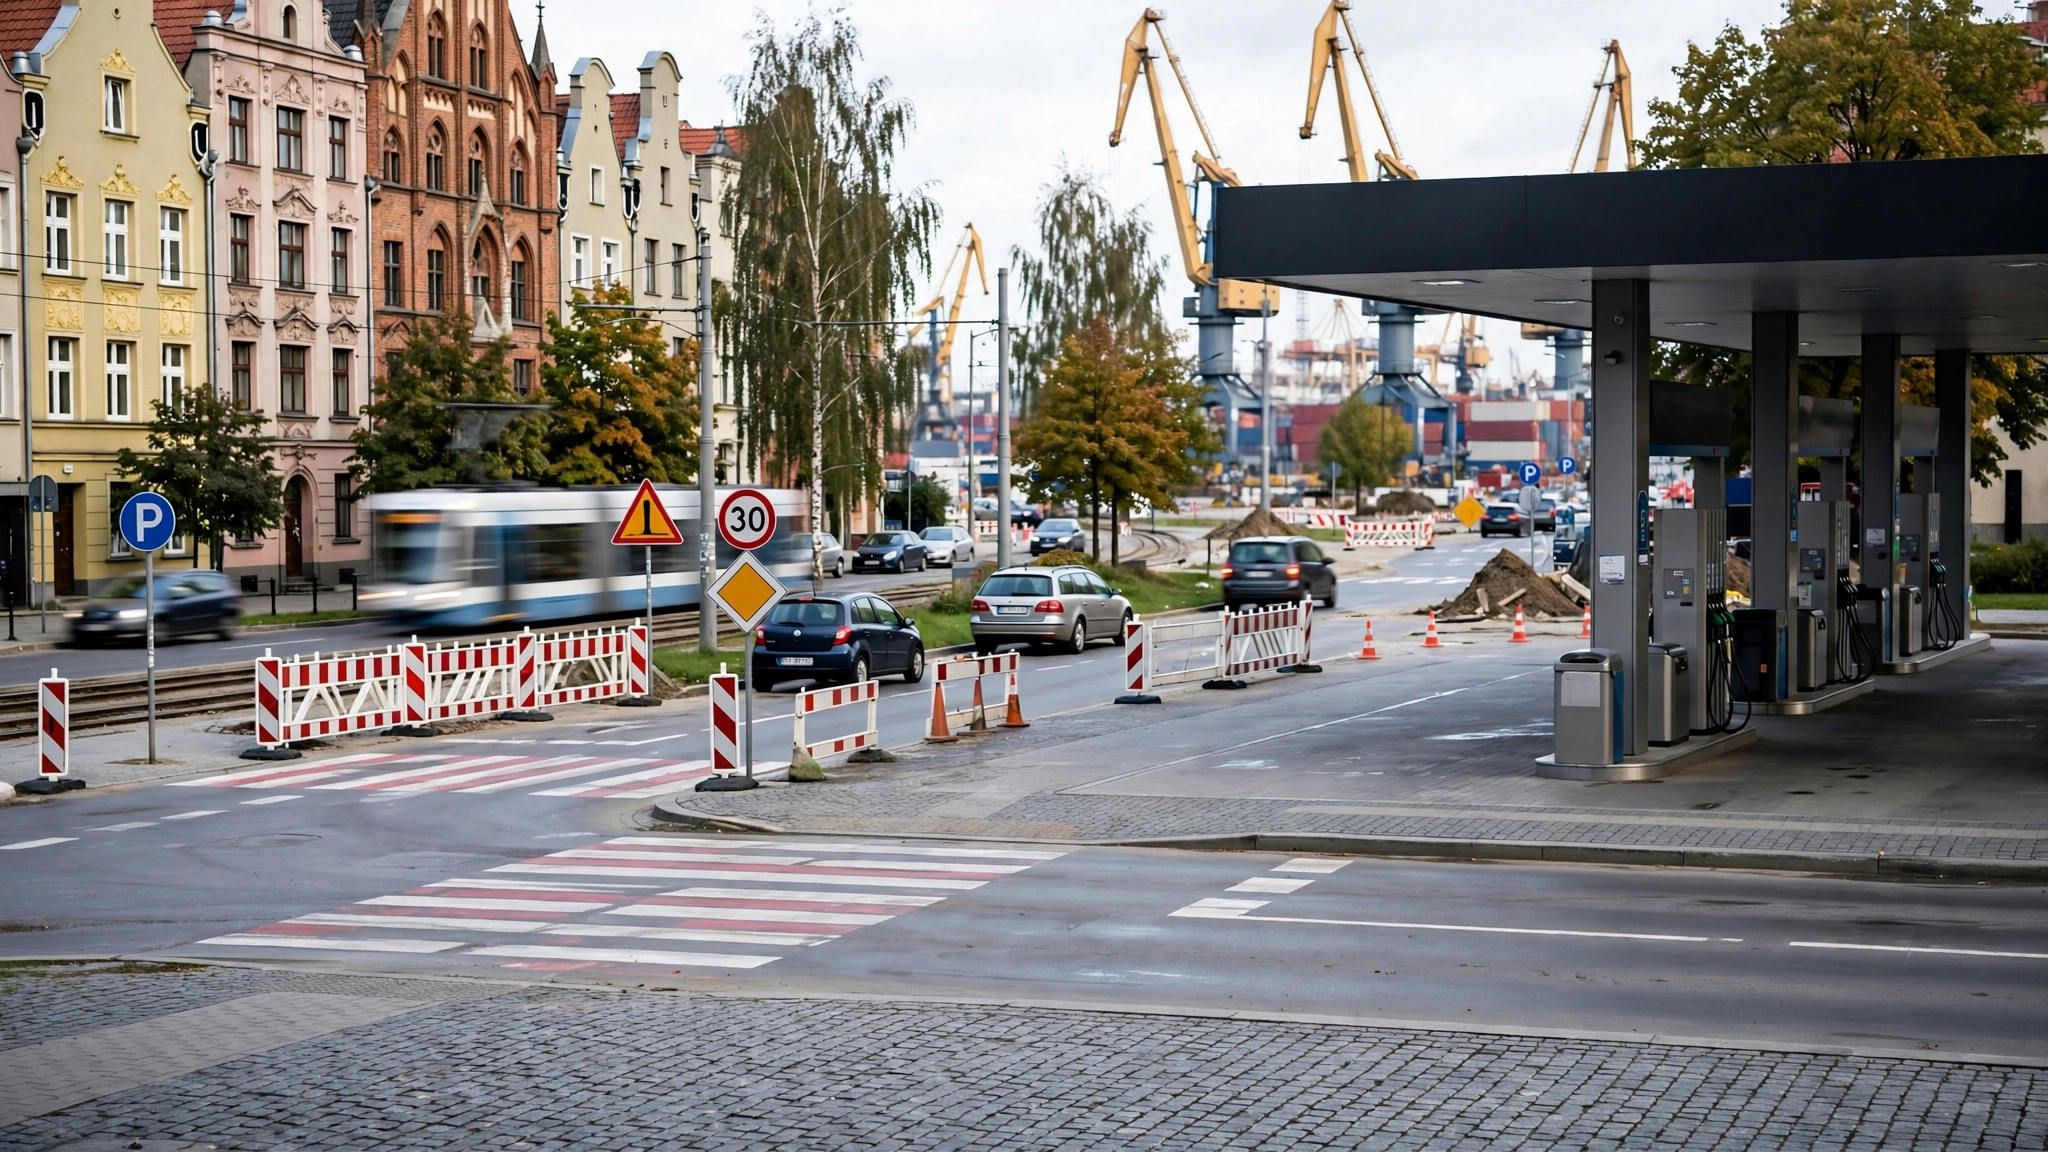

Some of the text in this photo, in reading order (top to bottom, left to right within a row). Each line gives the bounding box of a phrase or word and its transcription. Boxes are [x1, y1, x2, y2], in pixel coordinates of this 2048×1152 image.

[1525, 465, 1537, 481] P
[1563, 459, 1572, 473] P
[136, 503, 163, 542] P
[730, 506, 766, 532] 30
